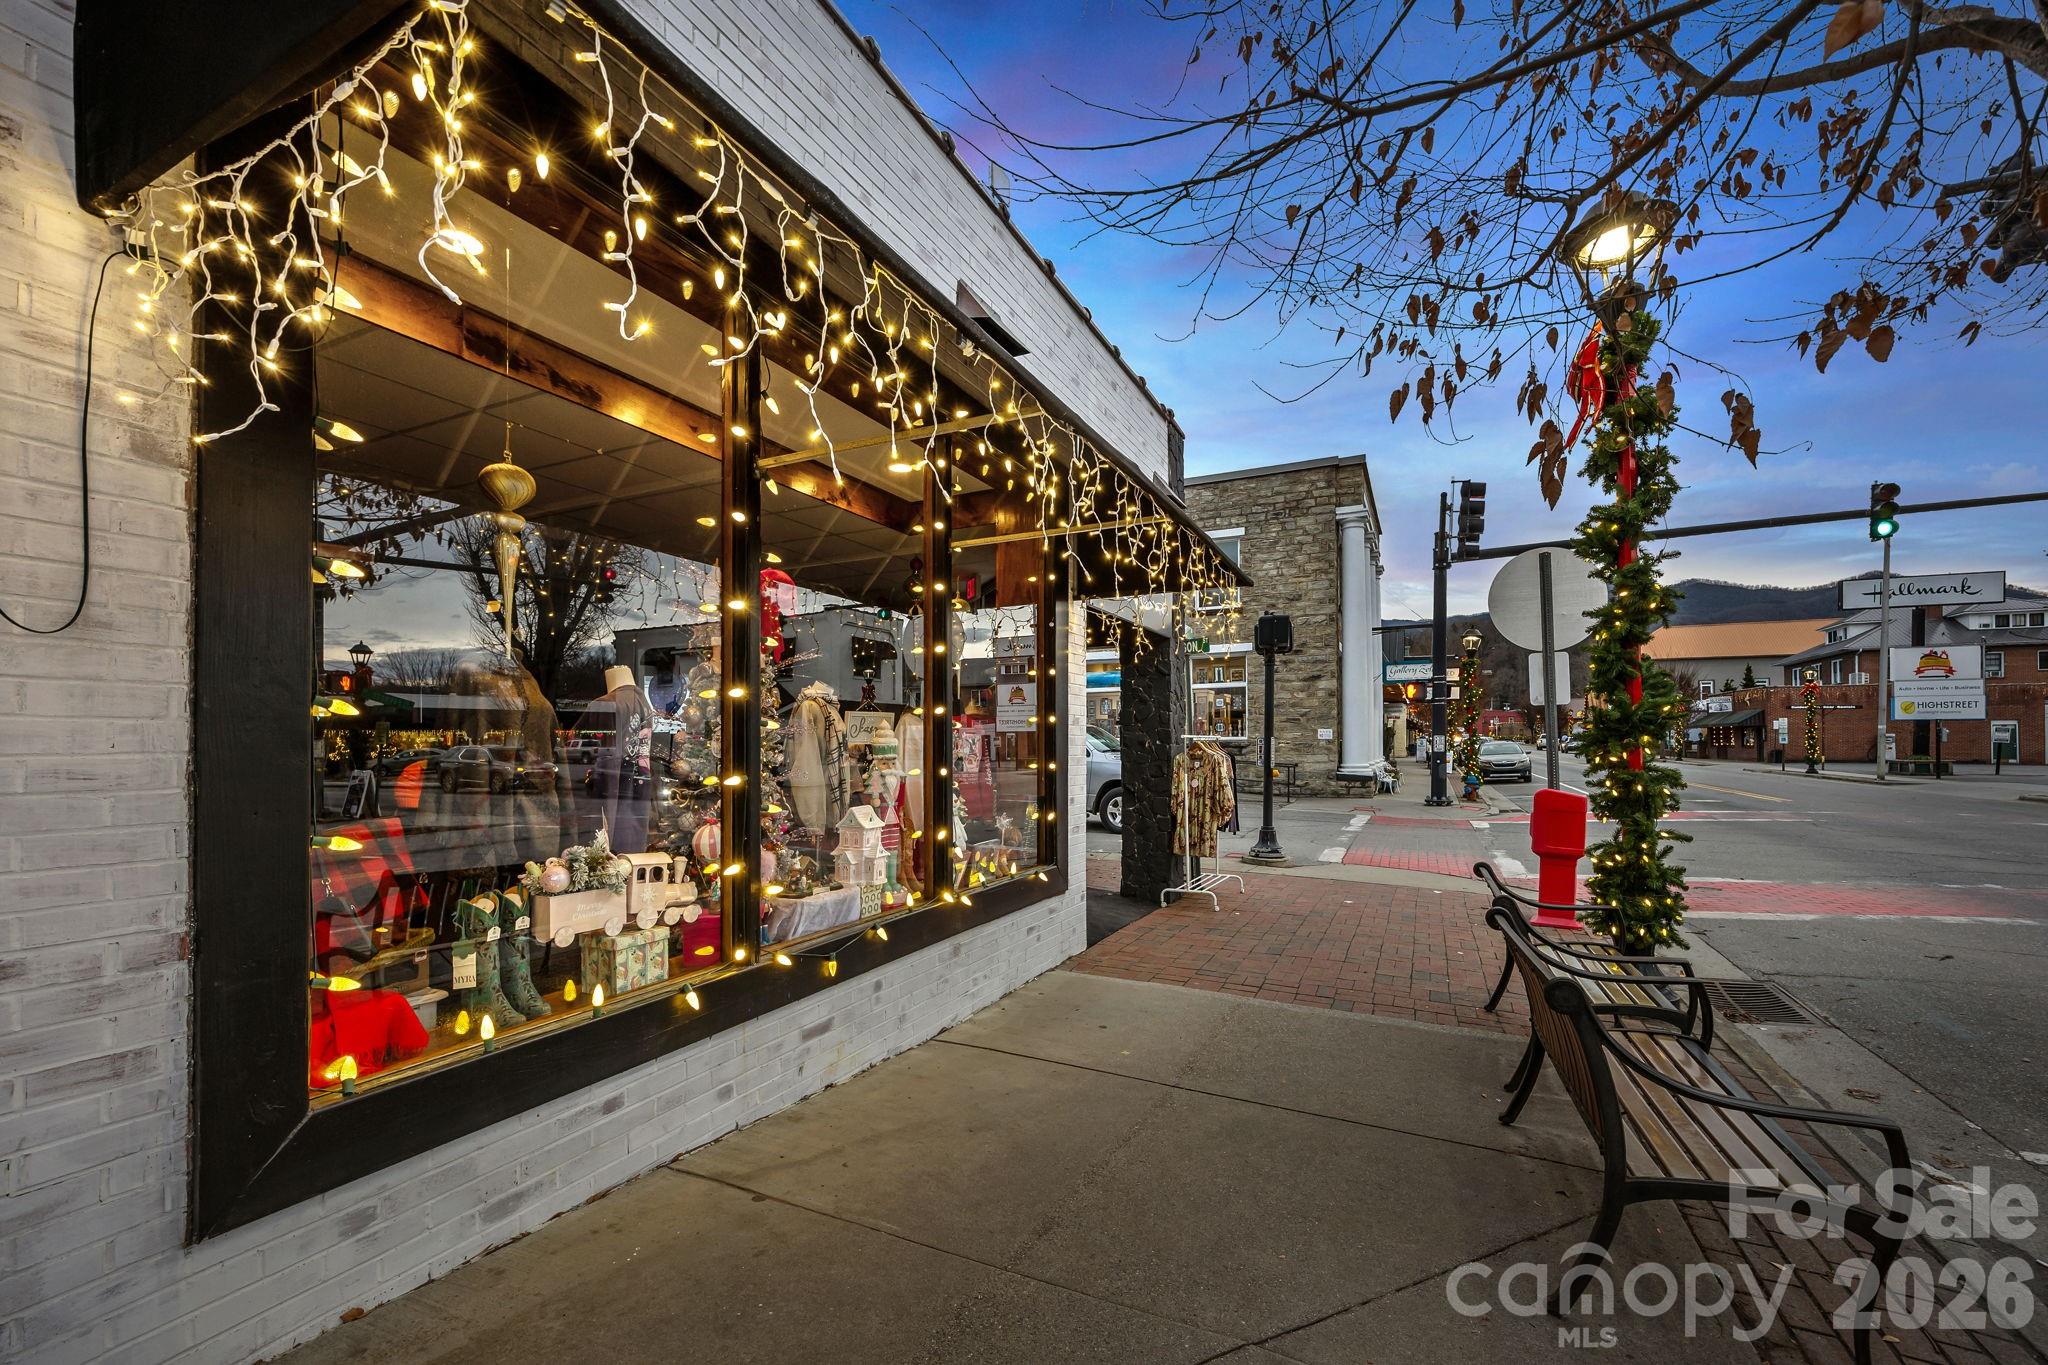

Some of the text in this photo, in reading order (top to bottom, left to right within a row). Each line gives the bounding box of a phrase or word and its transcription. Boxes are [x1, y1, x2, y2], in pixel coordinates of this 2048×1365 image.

[1861, 577, 1983, 605] Hallmark
[1917, 700, 1980, 709] HIGHSTREET
[453, 975, 476, 985] MYRA
